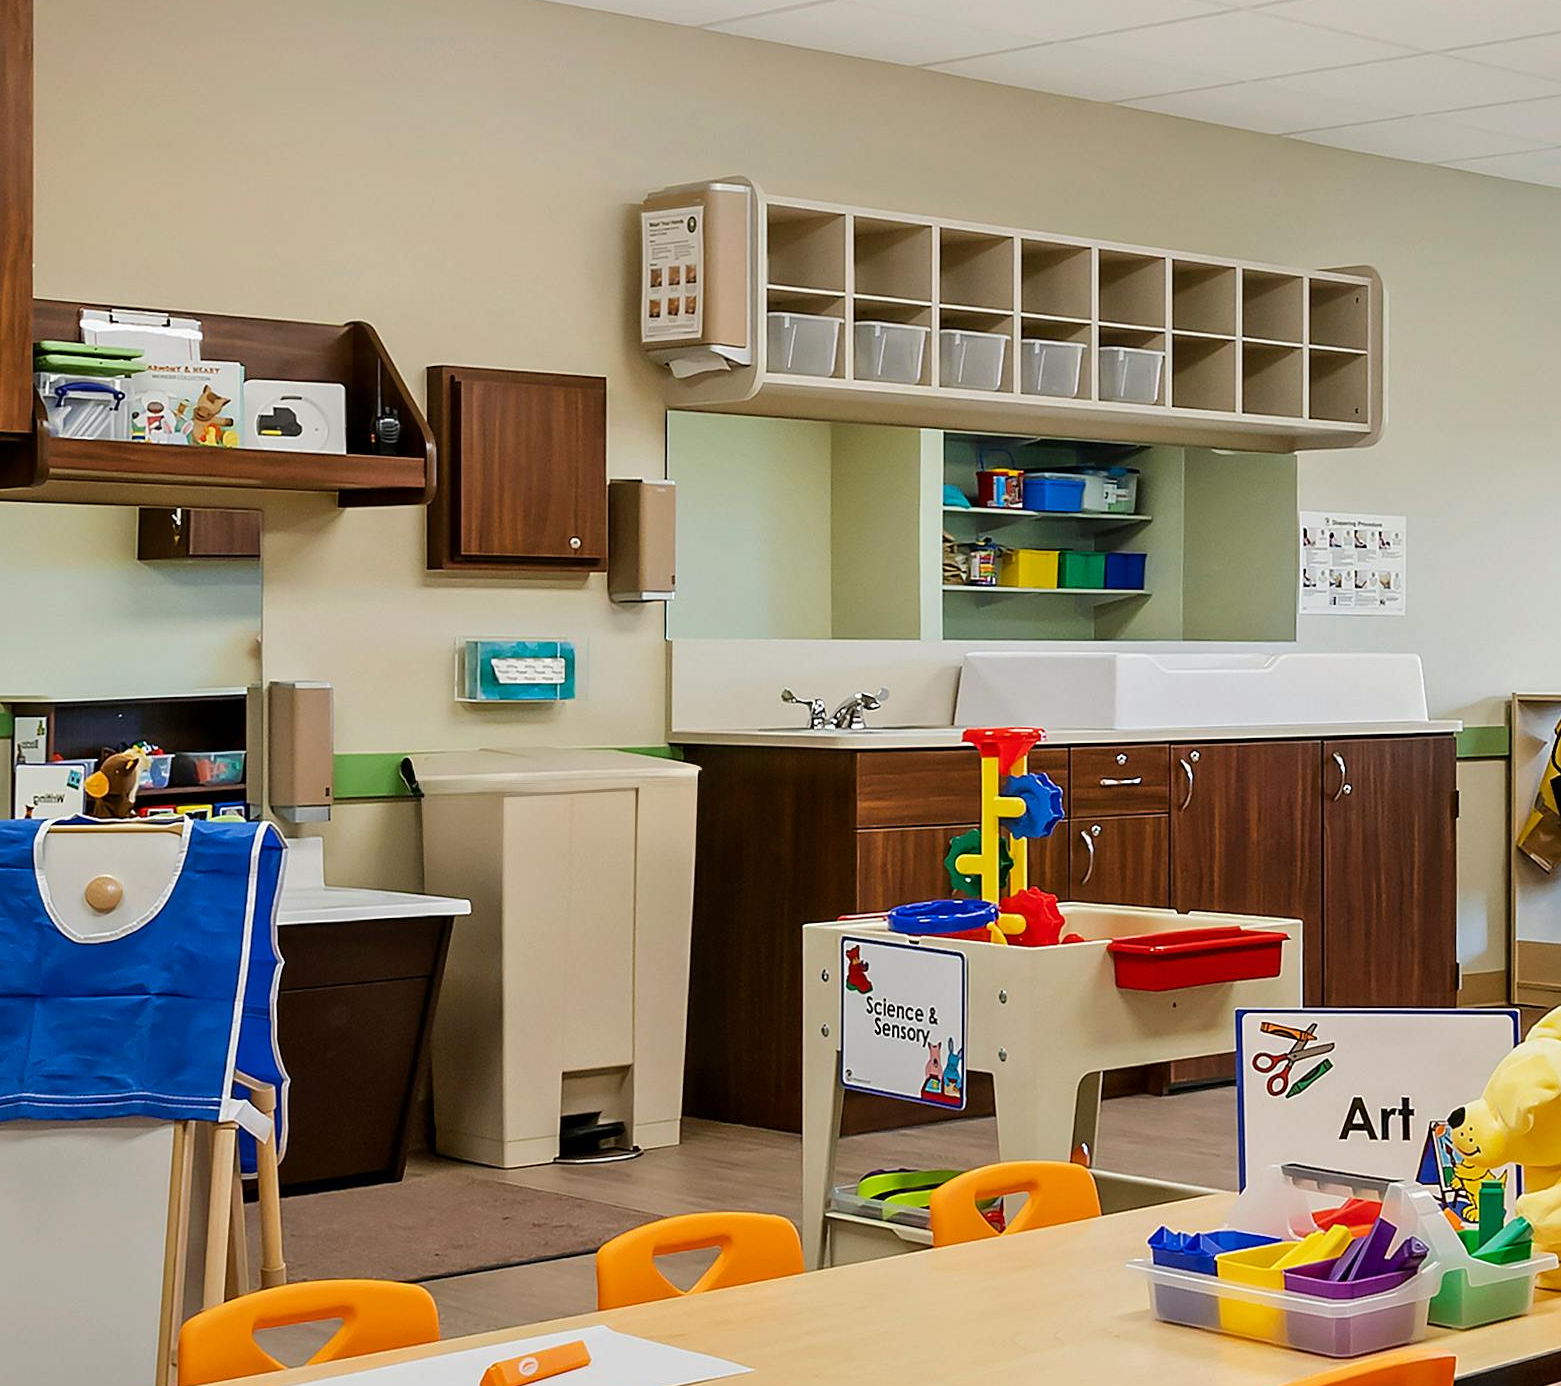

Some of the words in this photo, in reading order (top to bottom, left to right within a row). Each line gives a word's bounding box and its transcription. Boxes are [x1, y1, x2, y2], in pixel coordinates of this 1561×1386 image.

[147, 365, 181, 373] ARMONY
[866, 996, 925, 1022] Science
[928, 1006, 938, 1025] &
[874, 1017, 930, 1048] Sensory
[1339, 1096, 1415, 1141] Art
